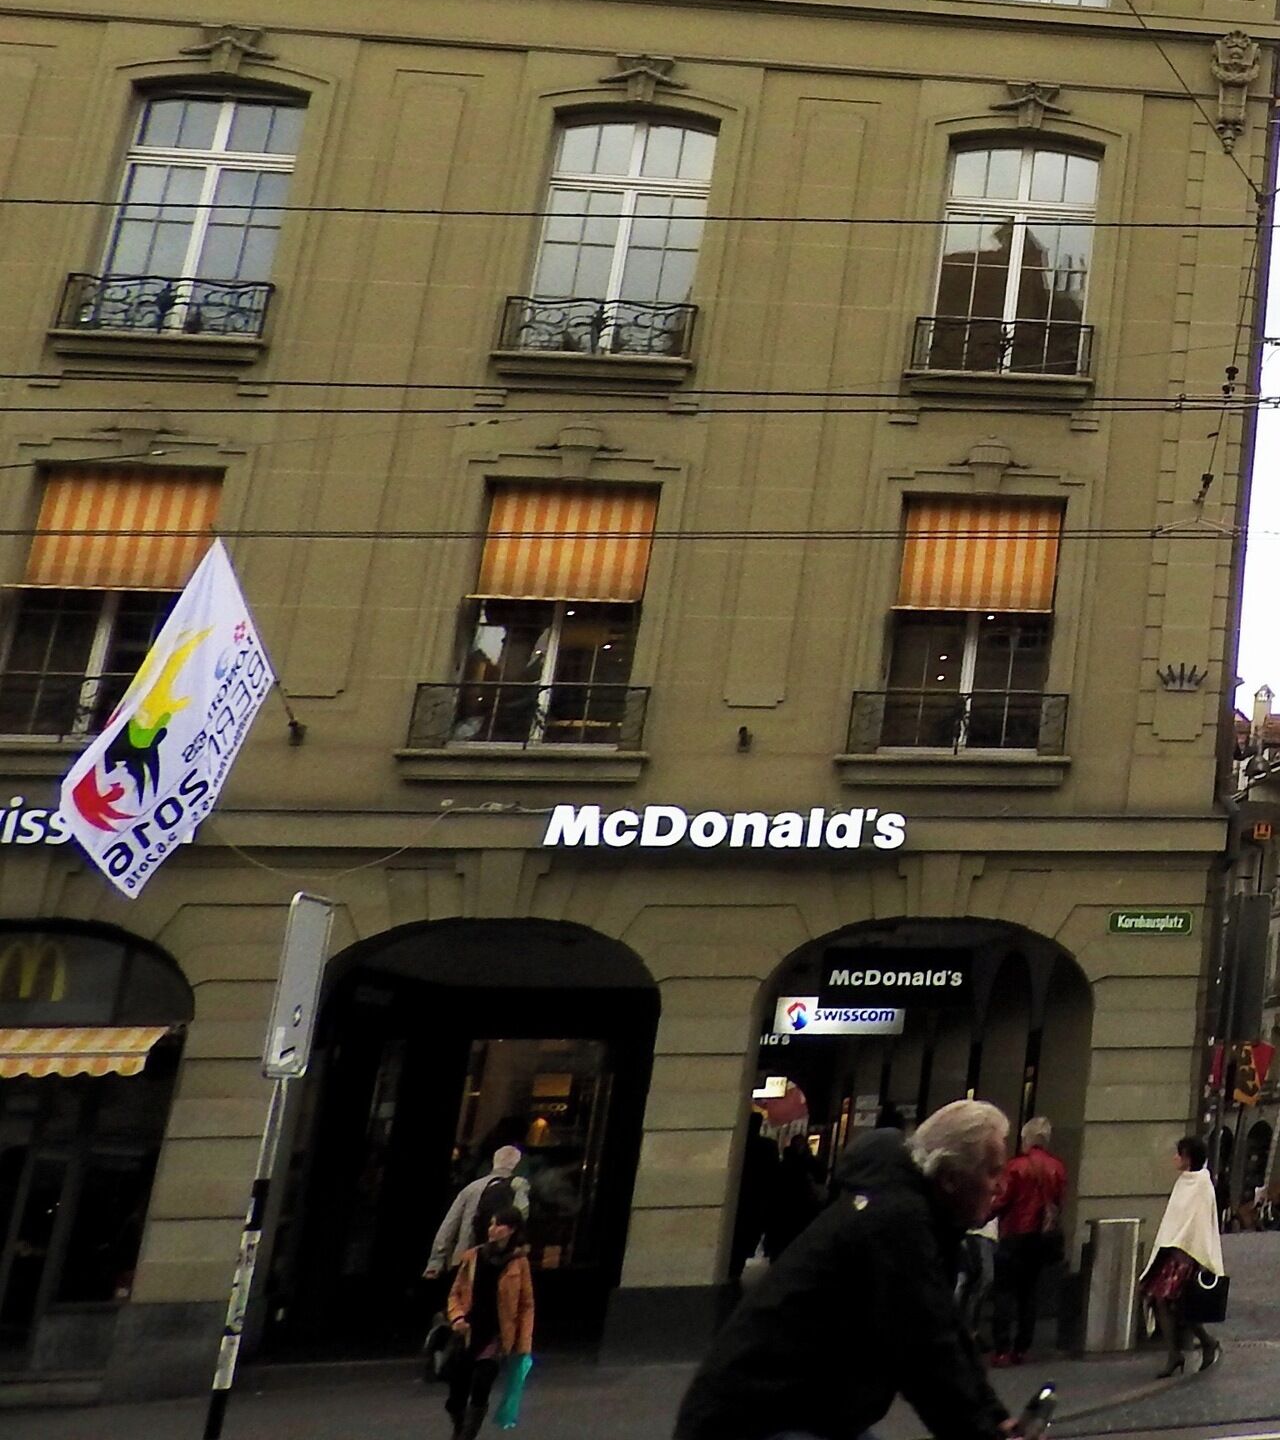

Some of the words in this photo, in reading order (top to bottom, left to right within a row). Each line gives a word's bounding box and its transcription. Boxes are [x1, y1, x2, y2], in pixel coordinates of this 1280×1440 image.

[543, 804, 906, 850] McDonald's
[1117, 914, 1185, 932] Kornhausplatz
[828, 969, 963, 987] McDonald's
[813, 1008, 896, 1023] swisscom
